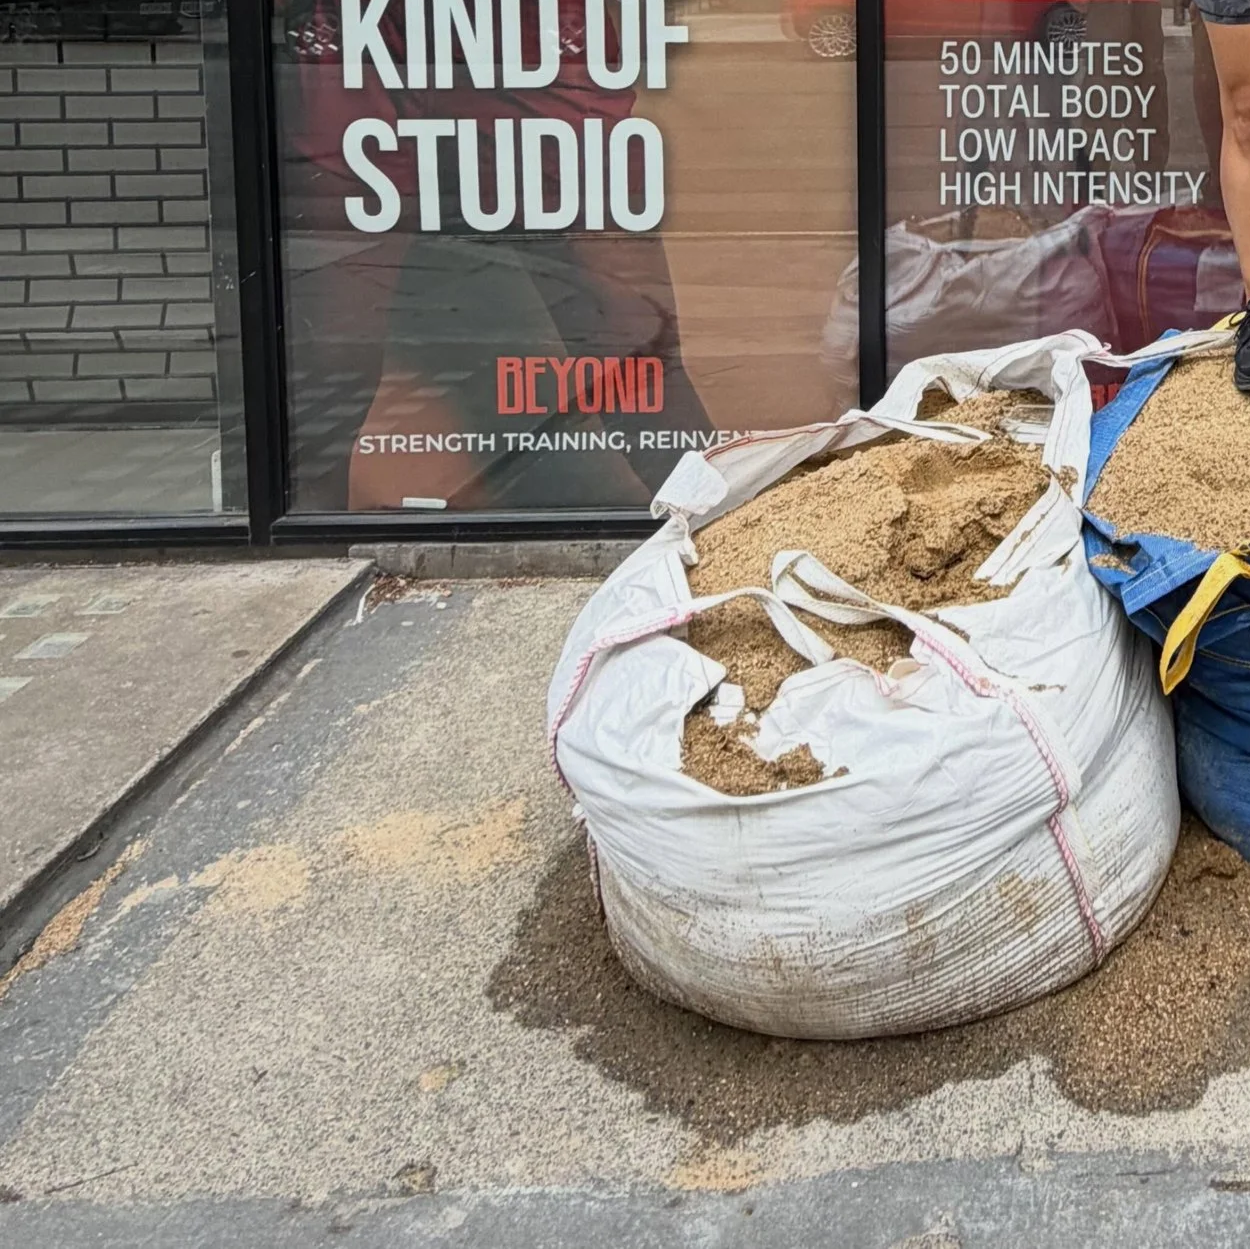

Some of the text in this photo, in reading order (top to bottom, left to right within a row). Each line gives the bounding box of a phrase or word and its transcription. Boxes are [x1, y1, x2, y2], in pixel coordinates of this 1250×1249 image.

[940, 41, 1144, 76] 50 MINUTES
[939, 85, 1156, 119] TOTAL BODY
[939, 128, 1157, 162] LOW IMPACT
[342, 117, 665, 233] STUDIO
[939, 171, 1205, 205] HIGH INTENSITY
[497, 356, 665, 415] BEYOND
[358, 431, 496, 454] STRENGTH
[502, 430, 632, 454] TRAINING,
